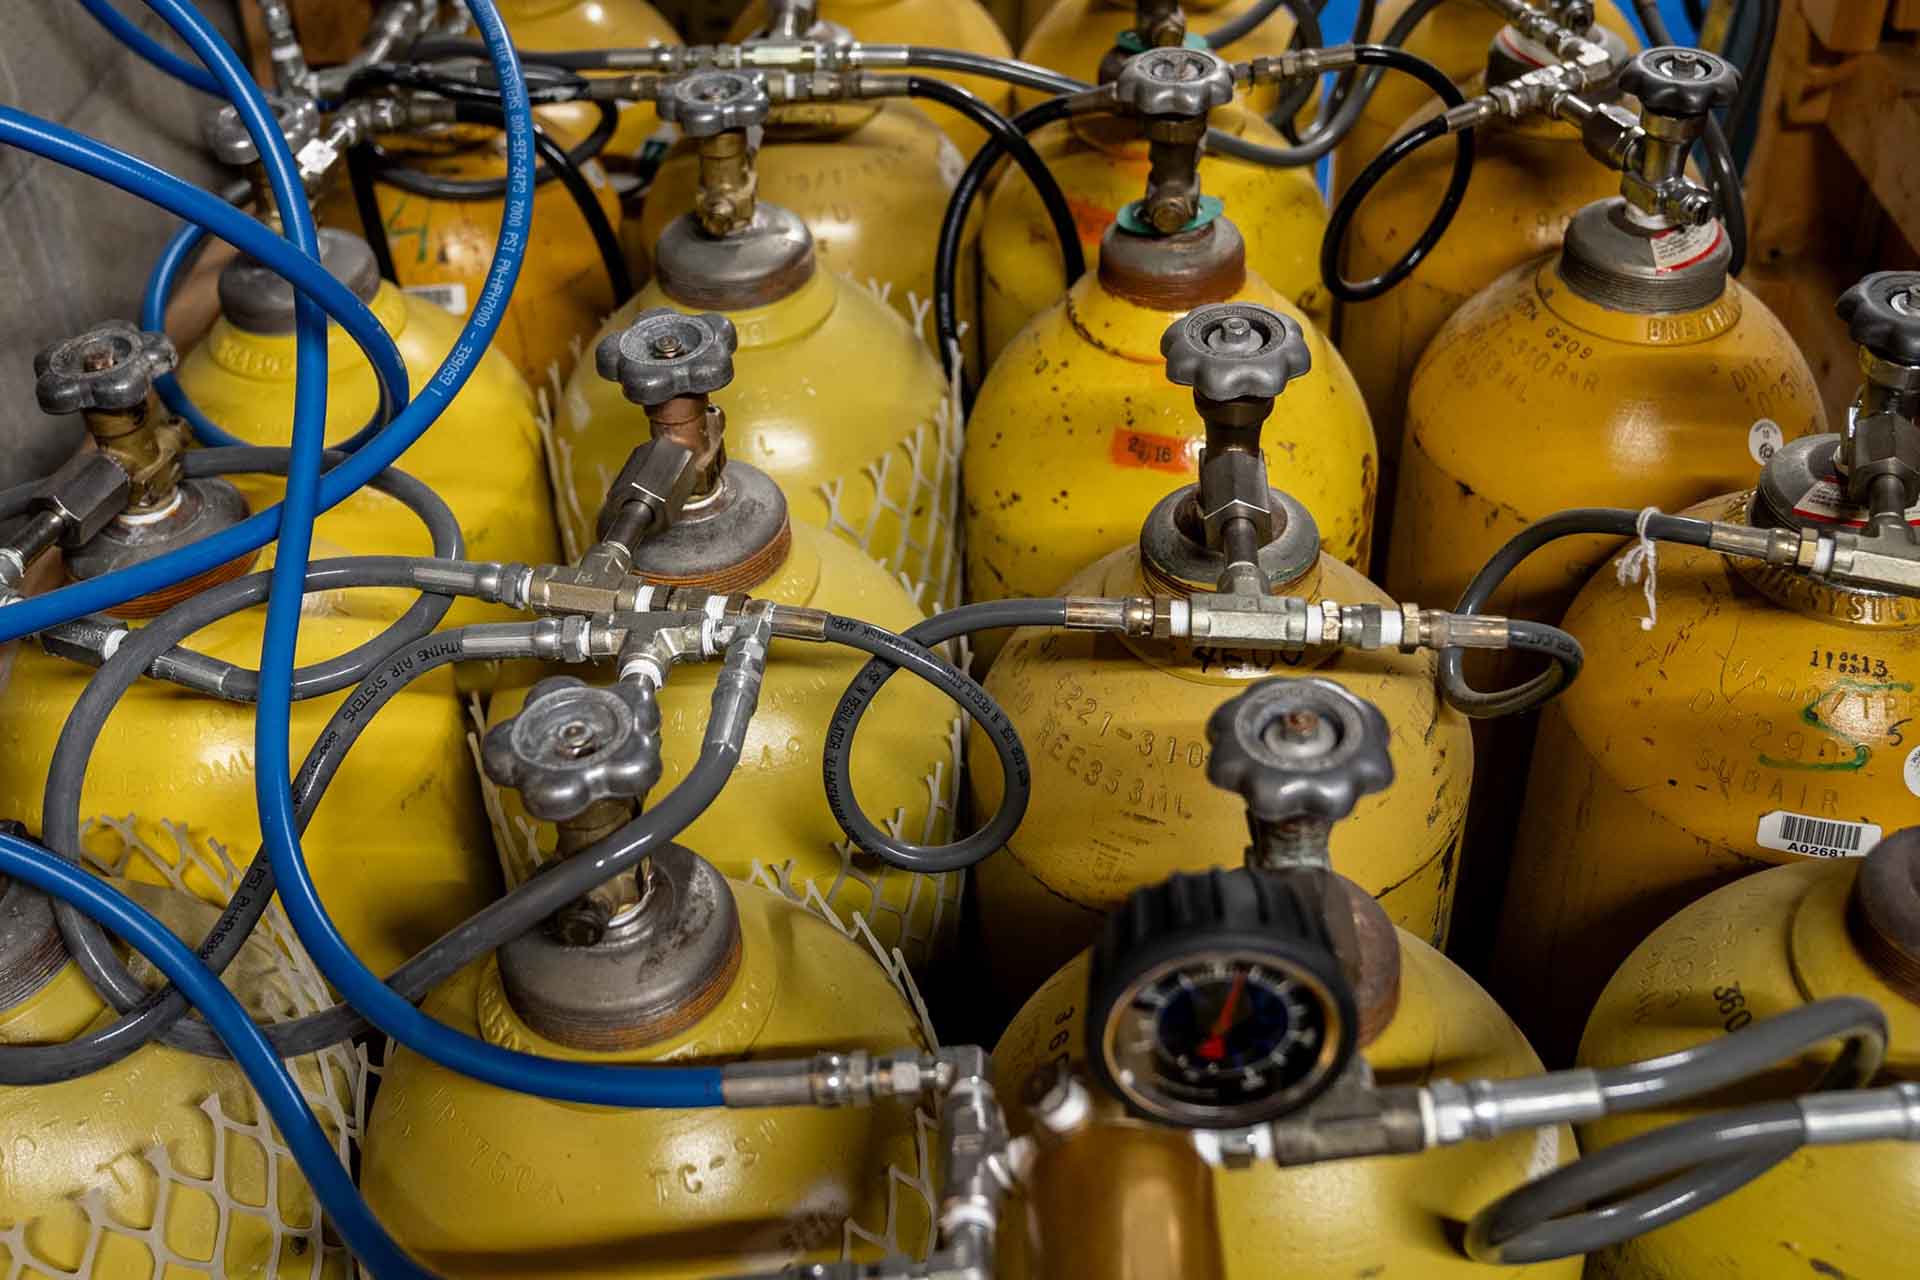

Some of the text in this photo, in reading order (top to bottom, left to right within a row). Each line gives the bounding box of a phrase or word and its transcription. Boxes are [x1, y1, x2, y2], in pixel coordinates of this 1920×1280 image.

[508, 200, 525, 227] 7000
[501, 232, 519, 253] PSI
[391, 656, 414, 678] AIR
[343, 677, 388, 722] SYSTEMS
[1787, 842, 1846, 857] A02681
